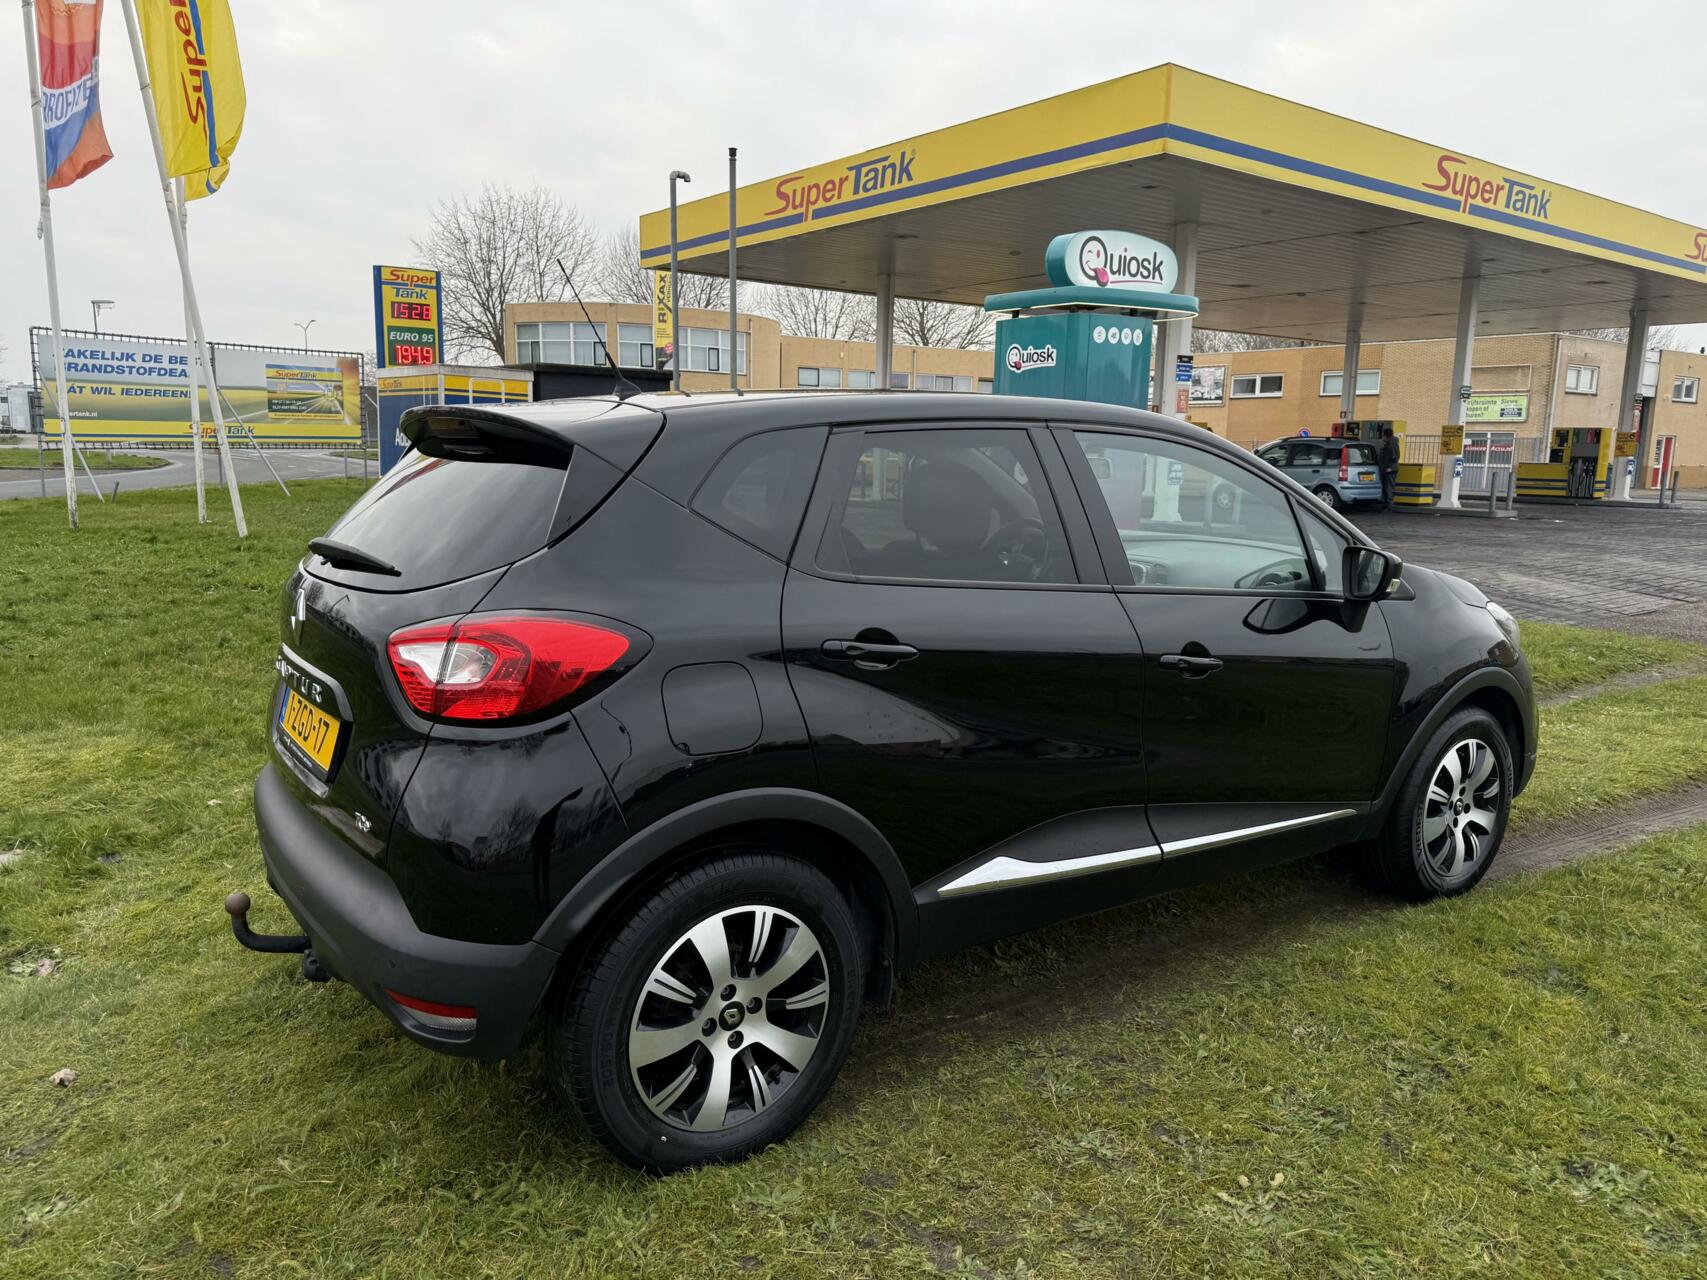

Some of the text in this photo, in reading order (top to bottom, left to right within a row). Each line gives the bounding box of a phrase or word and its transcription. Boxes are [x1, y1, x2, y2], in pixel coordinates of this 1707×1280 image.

[1079, 235, 1164, 286] Quiosk
[382, 269, 435, 287] Super
[391, 286, 428, 300] Tank
[389, 331, 434, 342] EURO 95
[54, 348, 136, 362] AKELIJK
[141, 353, 163, 365] DE
[1008, 345, 1055, 370] Quiosk
[55, 362, 189, 378] RANDSTOFDEA
[90, 386, 116, 395] WIL
